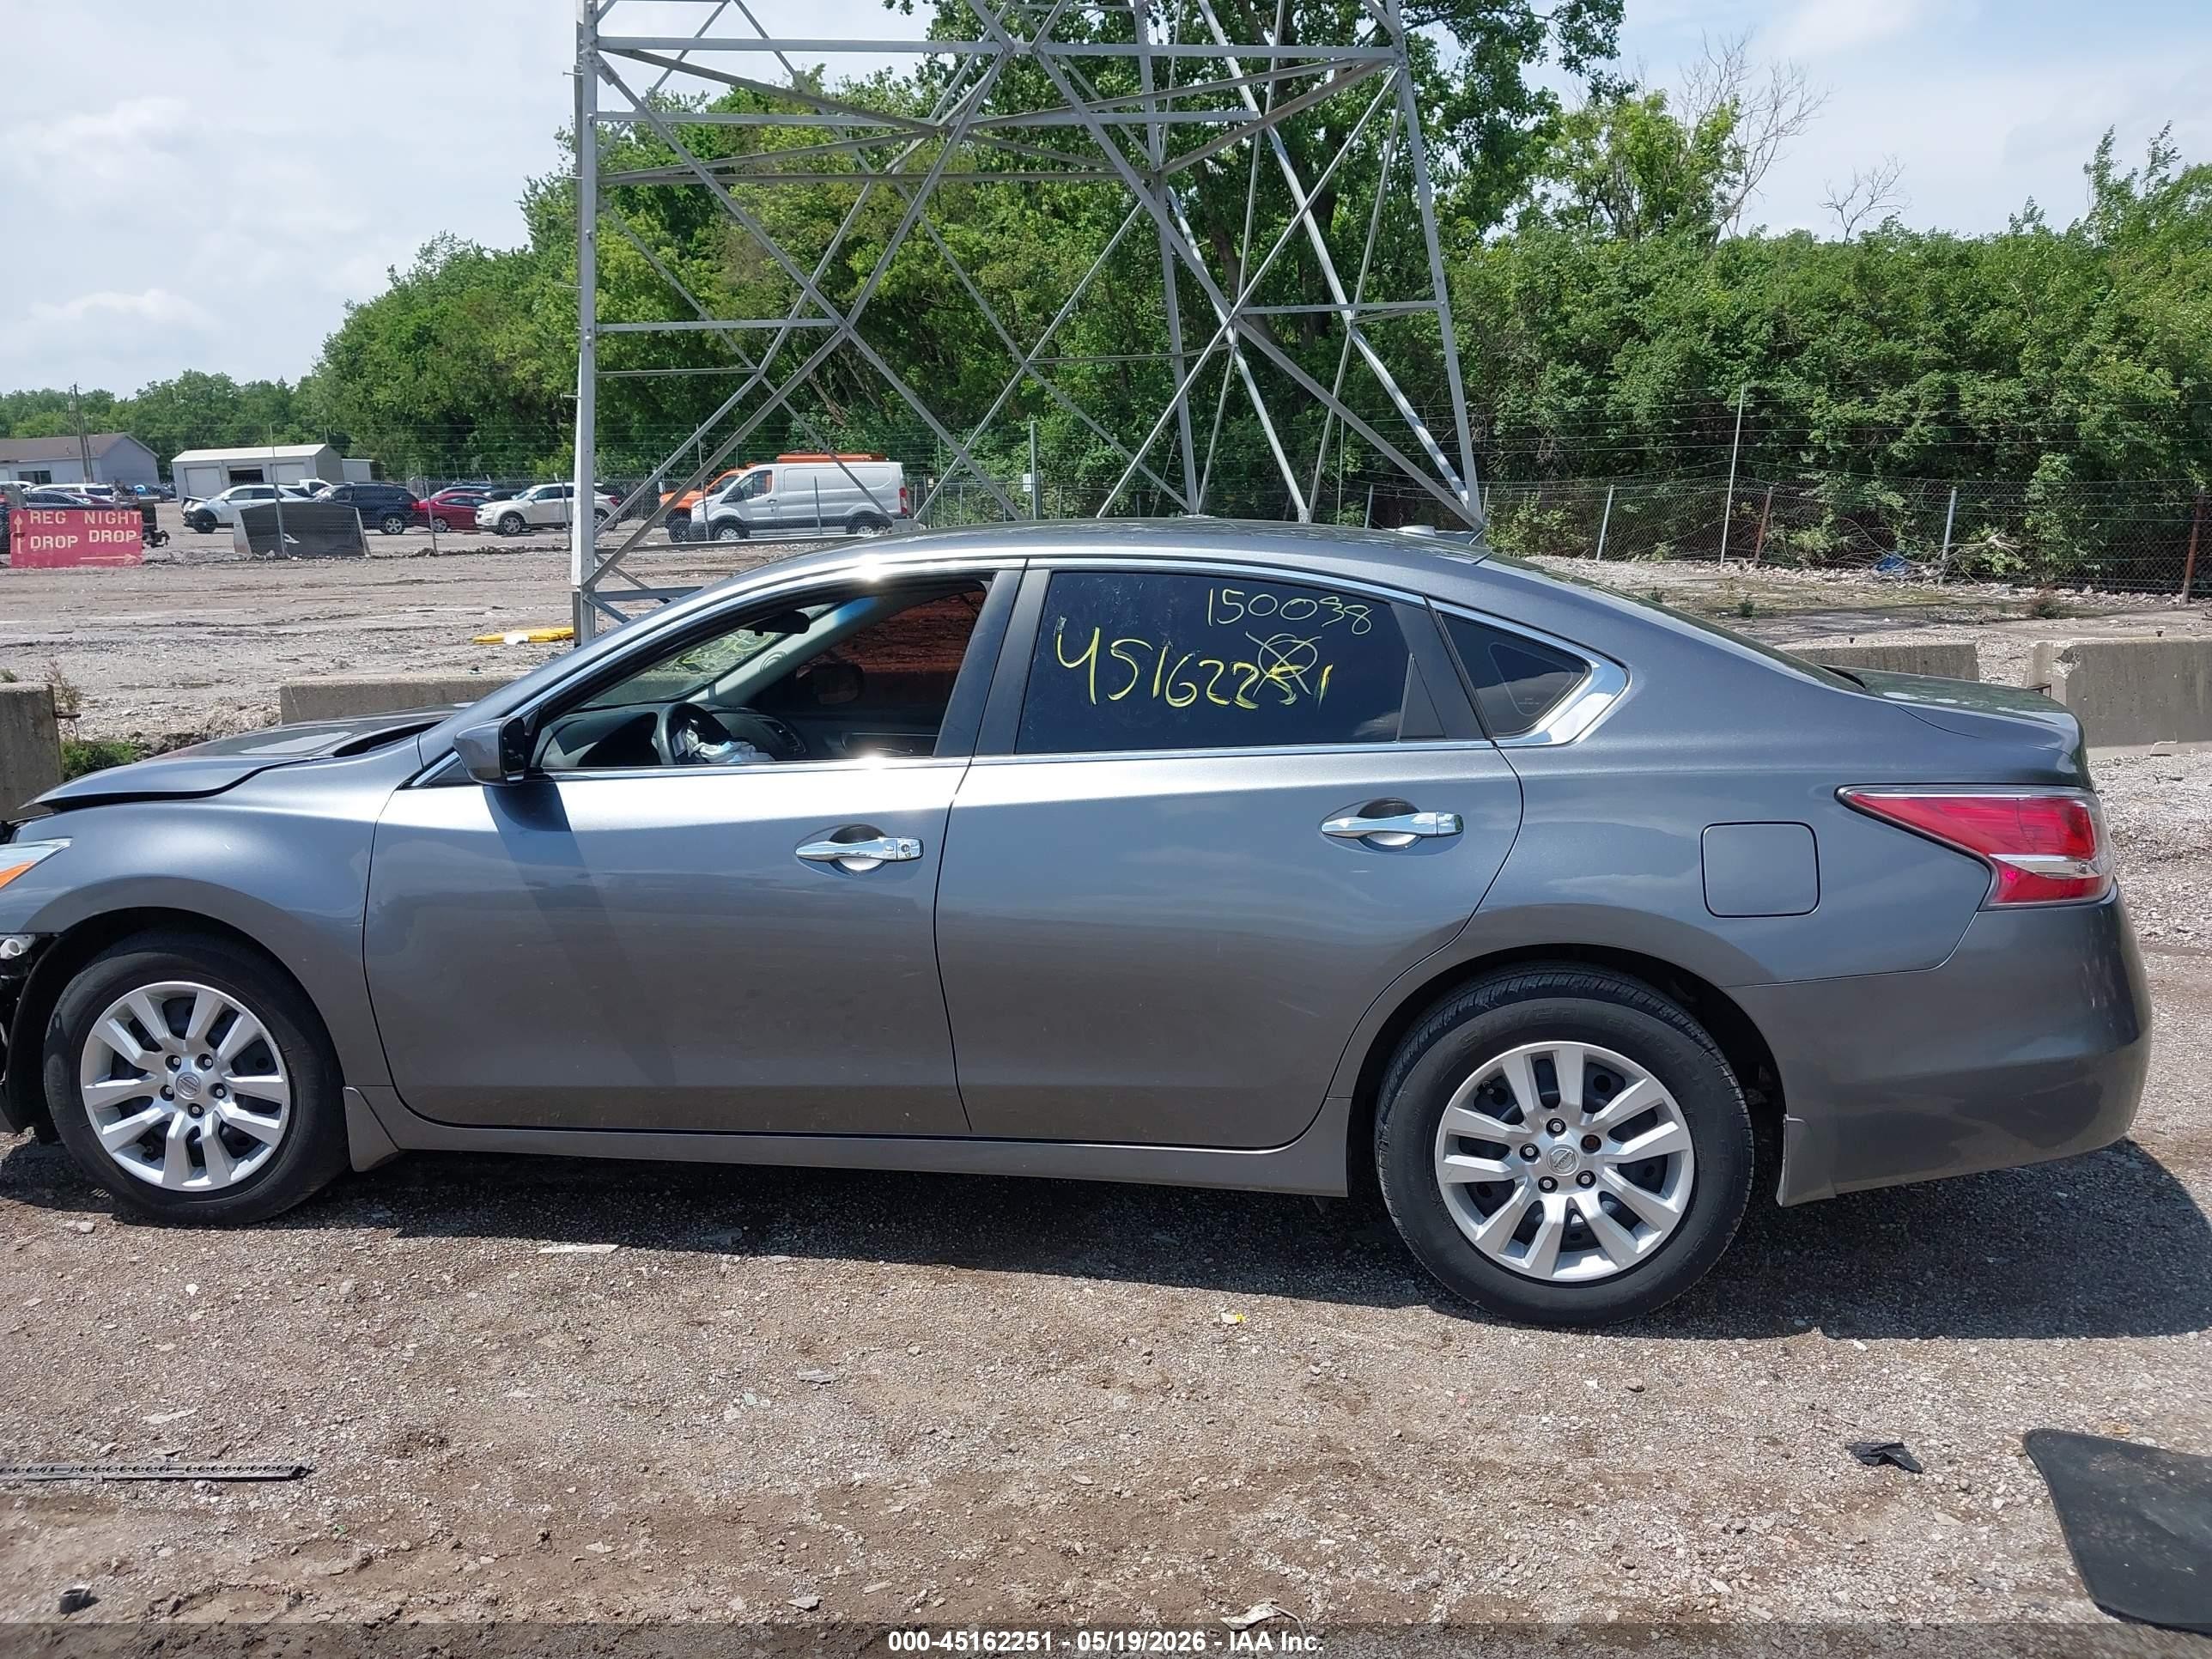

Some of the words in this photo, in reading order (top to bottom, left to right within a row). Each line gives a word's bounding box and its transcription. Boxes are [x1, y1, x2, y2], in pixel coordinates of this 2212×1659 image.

[30, 512, 66, 524] REG
[84, 512, 141, 524] NIGHT
[30, 536, 78, 549] DROP
[88, 530, 137, 543] DROP
[1207, 587, 1374, 635] 150038
